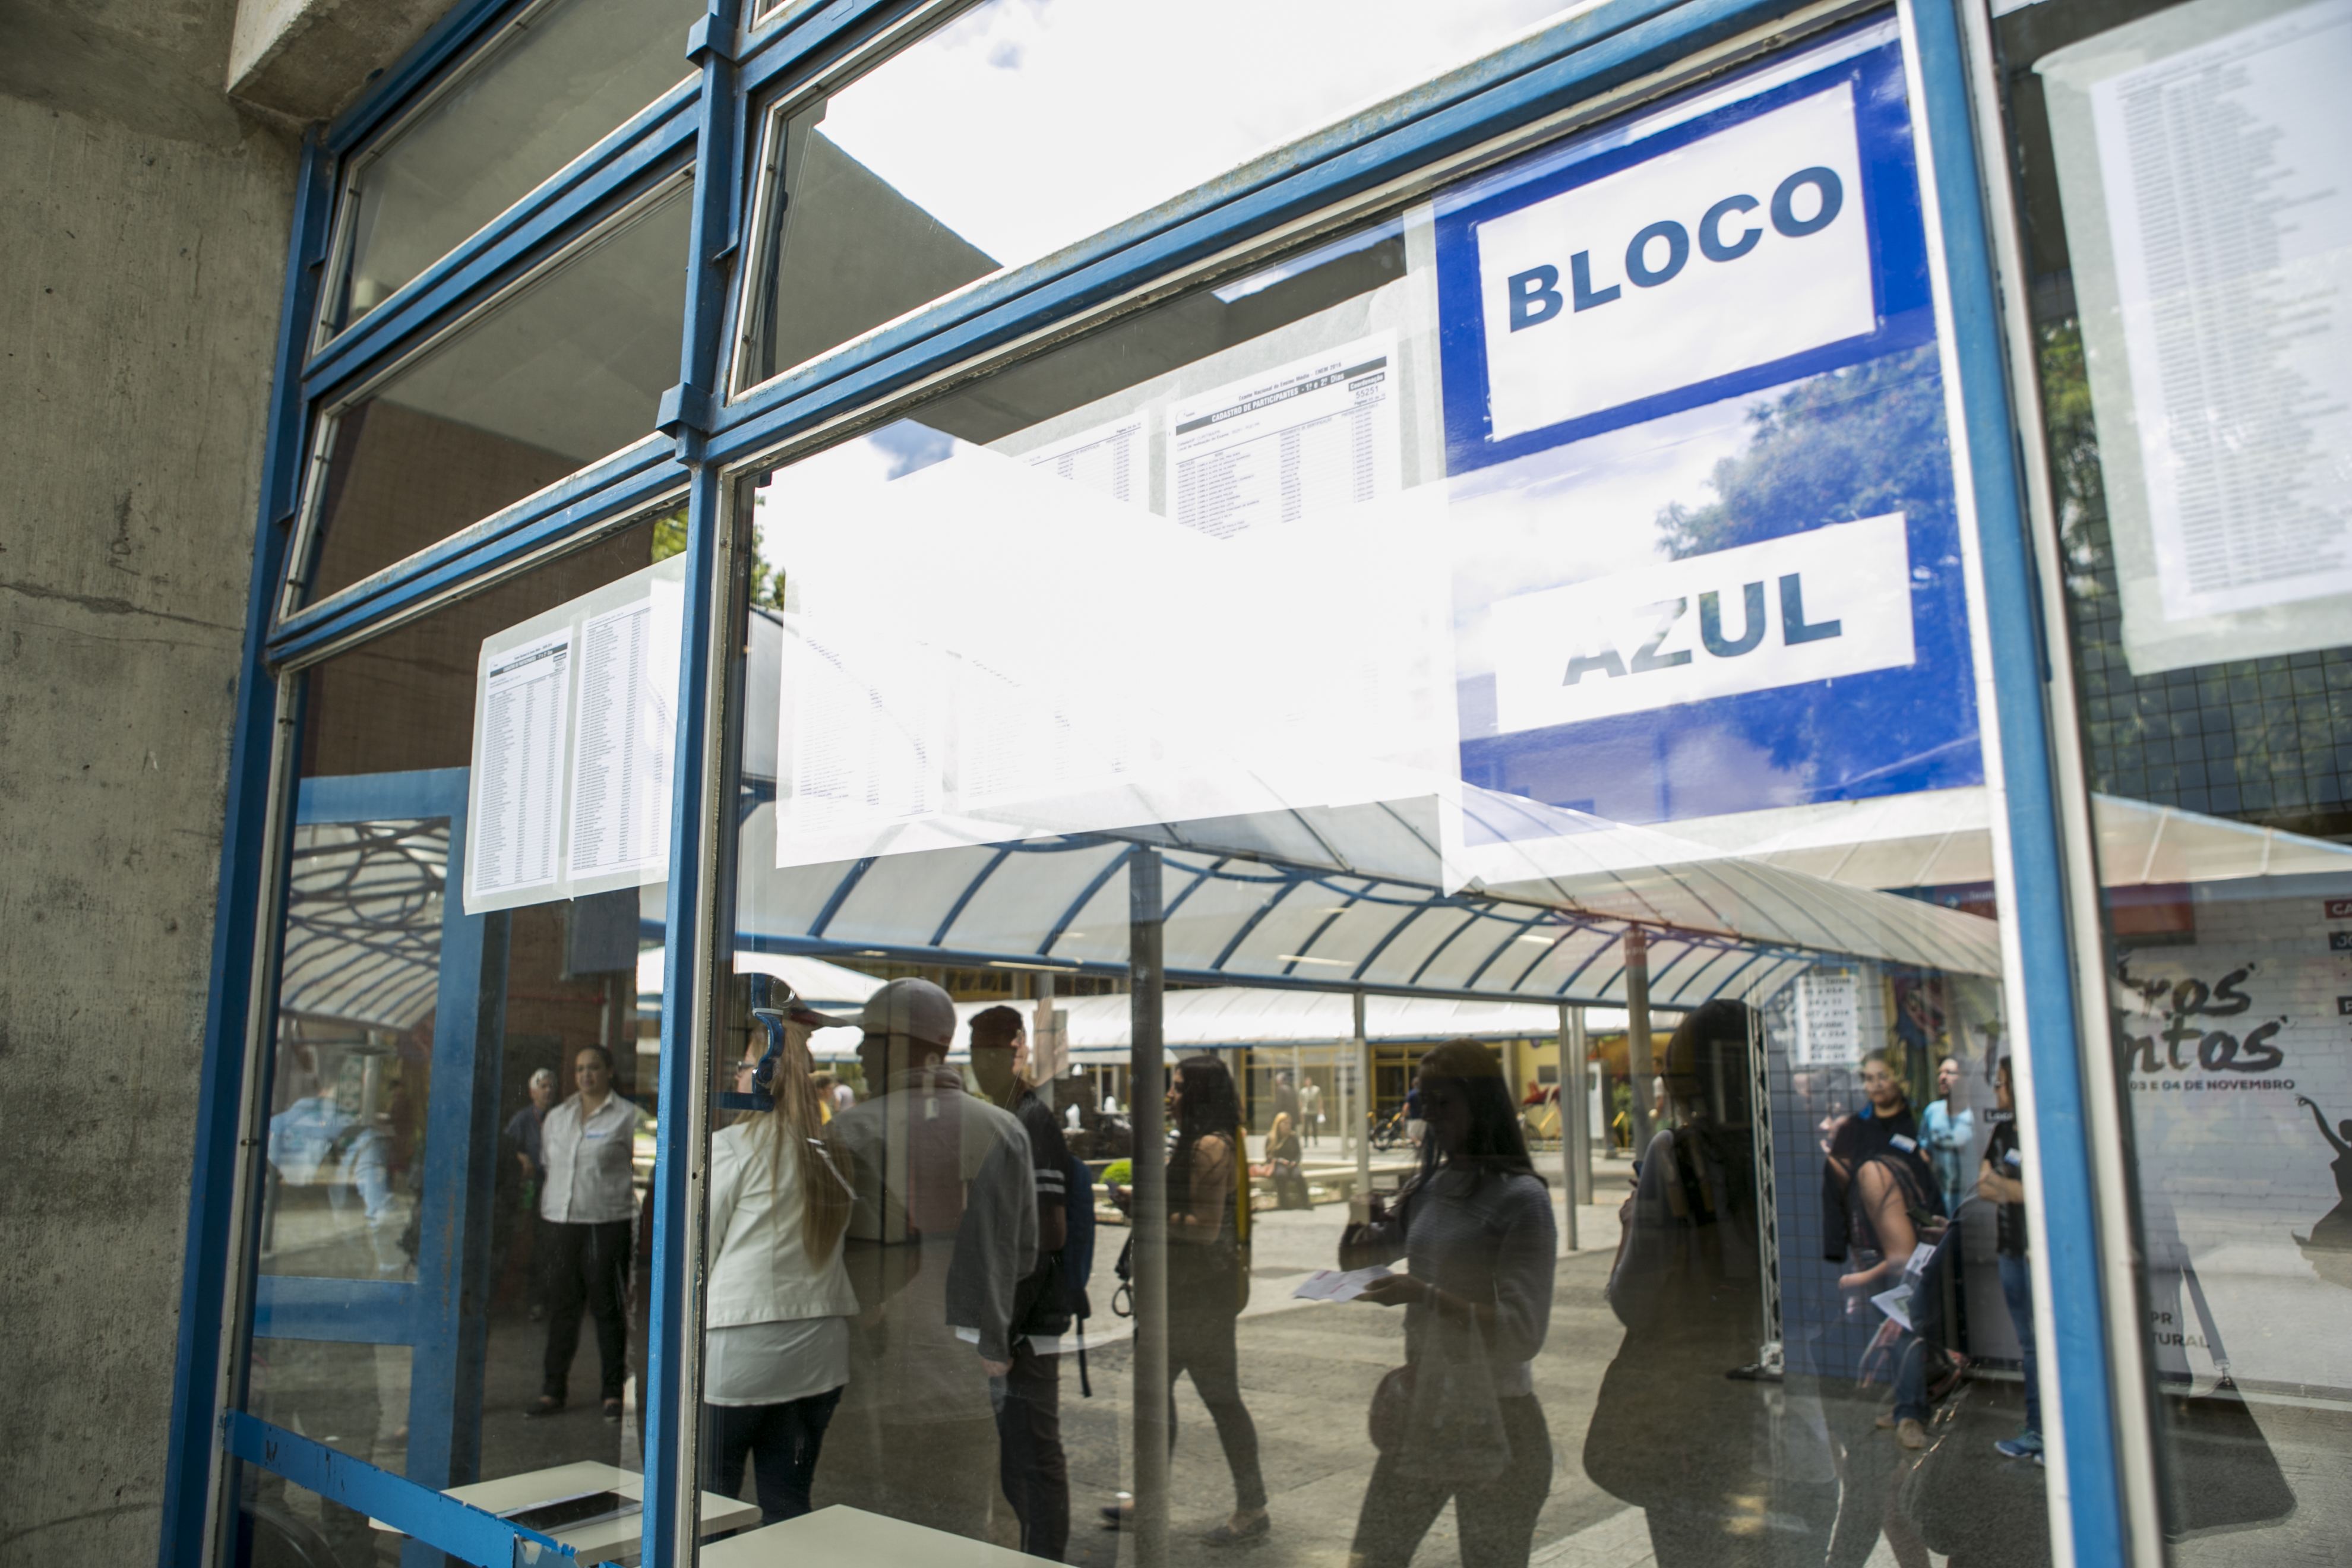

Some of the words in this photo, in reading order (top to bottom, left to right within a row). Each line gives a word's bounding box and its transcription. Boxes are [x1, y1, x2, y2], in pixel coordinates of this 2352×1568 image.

[1507, 166, 1844, 333] BLOCO
[1212, 404, 1243, 422] CADASTRO
[1243, 403, 1251, 411] DE
[1252, 387, 1299, 409] PARTICIPANTES
[1331, 372, 1345, 383] Dias
[1355, 385, 1379, 399] 55251
[1562, 572, 1842, 687] AZUL
[2151, 1081, 2158, 1090] E
[2162, 1081, 2180, 1090] 04
[2185, 1080, 2203, 1090] DE
[2207, 1079, 2294, 1090] NOVEMBRO
